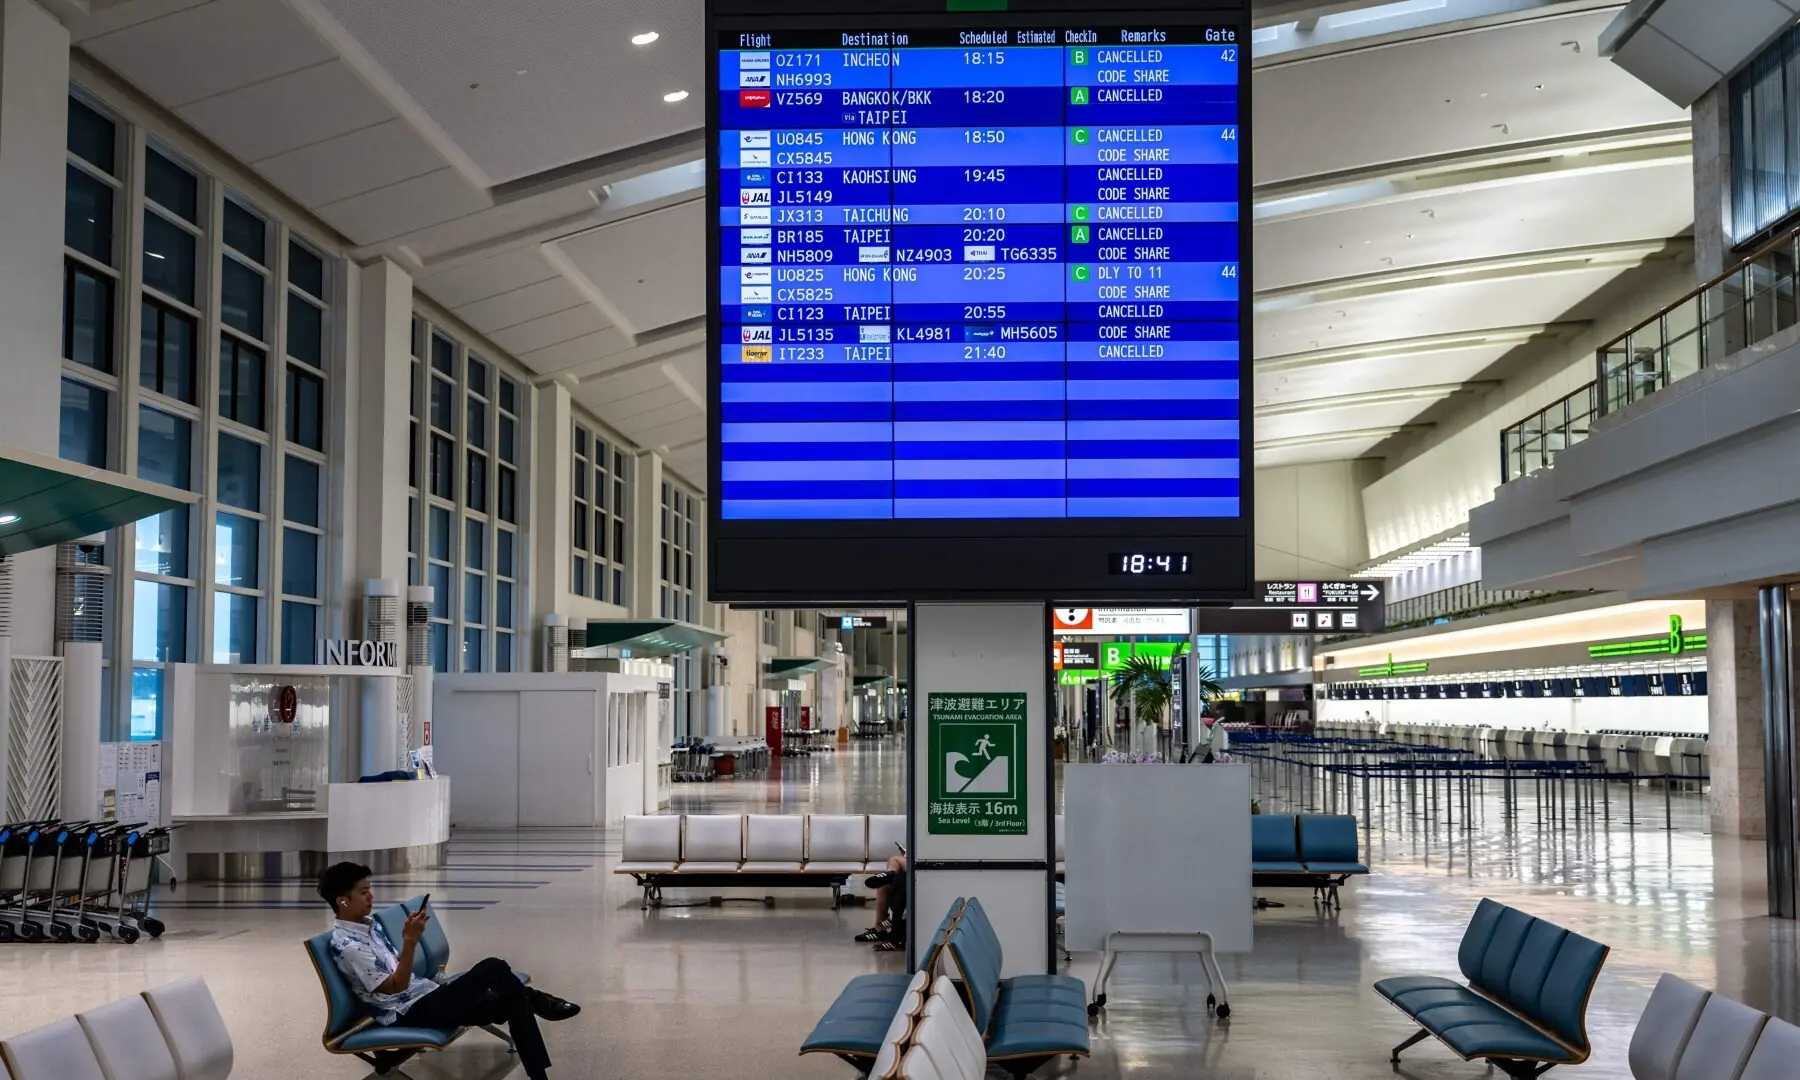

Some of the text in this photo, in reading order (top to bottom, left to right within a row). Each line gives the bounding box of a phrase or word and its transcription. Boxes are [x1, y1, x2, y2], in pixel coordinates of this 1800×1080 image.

[741, 29, 1234, 47] Flight Destination Scheduled Estimated CheckIn Remarks Gate
[776, 54, 819, 66] OZ171
[844, 53, 899, 66] INCHEON
[965, 52, 1004, 64] 18:15
[1076, 51, 1084, 63] B
[1098, 50, 1162, 63] CANCELLED
[1221, 50, 1235, 61] 42
[777, 73, 831, 85] NH6993
[1098, 70, 1126, 82] CODE
[1134, 70, 1169, 82] SHARE
[777, 93, 822, 105] VZ569
[843, 91, 931, 105] BANGKOK/BKK
[965, 91, 1004, 103] 18:20
[1076, 90, 1084, 101] A
[1098, 89, 1162, 101] CANCELLED
[859, 111, 906, 124] TAIPEI
[777, 133, 822, 145] UO845
[843, 132, 874, 145] HONG
[883, 131, 916, 144] KONG
[965, 131, 1004, 143] 18:50
[1076, 130, 1084, 142] C
[1098, 129, 1162, 142] CANCELLED
[1221, 129, 1235, 140] 44
[777, 152, 832, 164] CX5845
[1098, 149, 1126, 161] CODE
[1134, 149, 1169, 161] SHARE
[777, 168, 1162, 183] CI133 KAOHSIUNG 19:45 CANCELLED
[751, 187, 1169, 203] JAL JL5149 CODE SHARE
[778, 210, 822, 222] JX313
[843, 208, 908, 222] TAICHUNG
[964, 208, 1005, 220] 20:10
[1076, 207, 1084, 219] C
[1098, 207, 1162, 219] CANCELLED
[778, 231, 823, 243] BR185
[844, 229, 890, 243] TAIPEI
[964, 229, 1005, 241] 20:20
[1076, 228, 1085, 240] A
[1099, 228, 1162, 240] CANCELLED
[778, 250, 832, 262] NH5809
[897, 249, 951, 261] NZ4903
[1001, 248, 1056, 260] TG6335
[1099, 248, 1126, 259] CODE
[1135, 247, 1169, 259] SHARE
[778, 269, 823, 281] UO825
[844, 268, 875, 281] HONG
[884, 268, 916, 281] KONG
[964, 268, 1005, 280] 20:25
[1076, 267, 1085, 279] C
[1099, 267, 1119, 279] DLY
[1127, 267, 1141, 278] TO
[1150, 266, 1161, 278] 11
[1222, 266, 1236, 277] 44
[778, 289, 832, 300] CX5825
[1099, 286, 1126, 298] CODE
[1135, 286, 1169, 298] SHARE
[778, 305, 1163, 320] CI123 TAIPEI 20:55 CANCELLED
[752, 331, 771, 340] JAL
[779, 329, 833, 341] JL5135
[898, 328, 949, 340] KL4981
[1001, 327, 1057, 339] MH5605
[1099, 326, 1127, 338] CODE
[1135, 326, 1170, 338] SHARE
[780, 348, 824, 360] IT233
[845, 347, 890, 360] TAIPEI
[965, 346, 1005, 358] 21:40
[1099, 345, 1163, 357] CANCELLED
[1123, 555, 1187, 573] 18:41
[1669, 614, 1682, 654] B
[1108, 648, 1120, 664] B
[930, 698, 1024, 710] 津波避難エリア
[930, 802, 1017, 814] 海抜表示 16m
